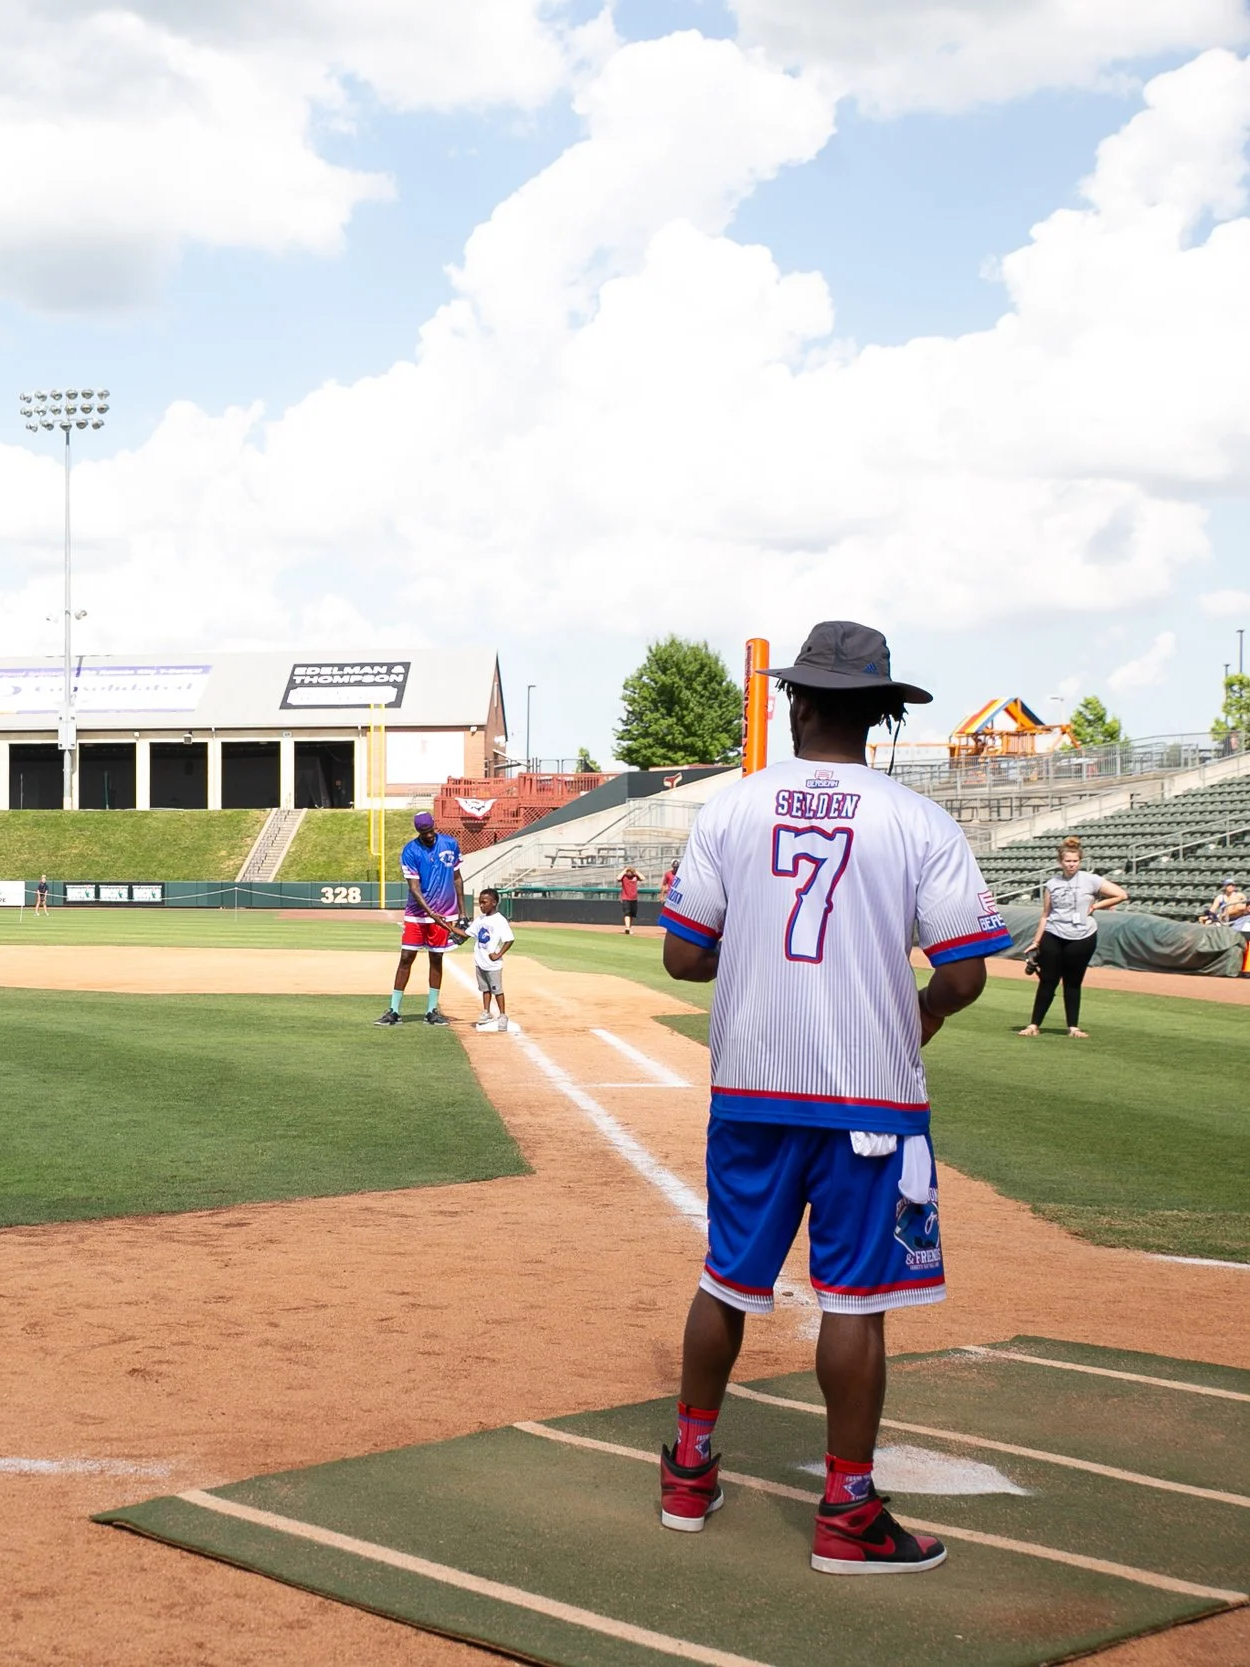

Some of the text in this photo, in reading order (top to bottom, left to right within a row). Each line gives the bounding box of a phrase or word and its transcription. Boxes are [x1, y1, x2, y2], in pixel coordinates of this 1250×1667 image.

[293, 665, 406, 675] EDELMAN &
[293, 674, 405, 684] THOMPSON
[776, 789, 861, 820] SELDEN
[320, 886, 362, 904] 328
[772, 824, 854, 964] 7
[905, 1253, 914, 1265] &
